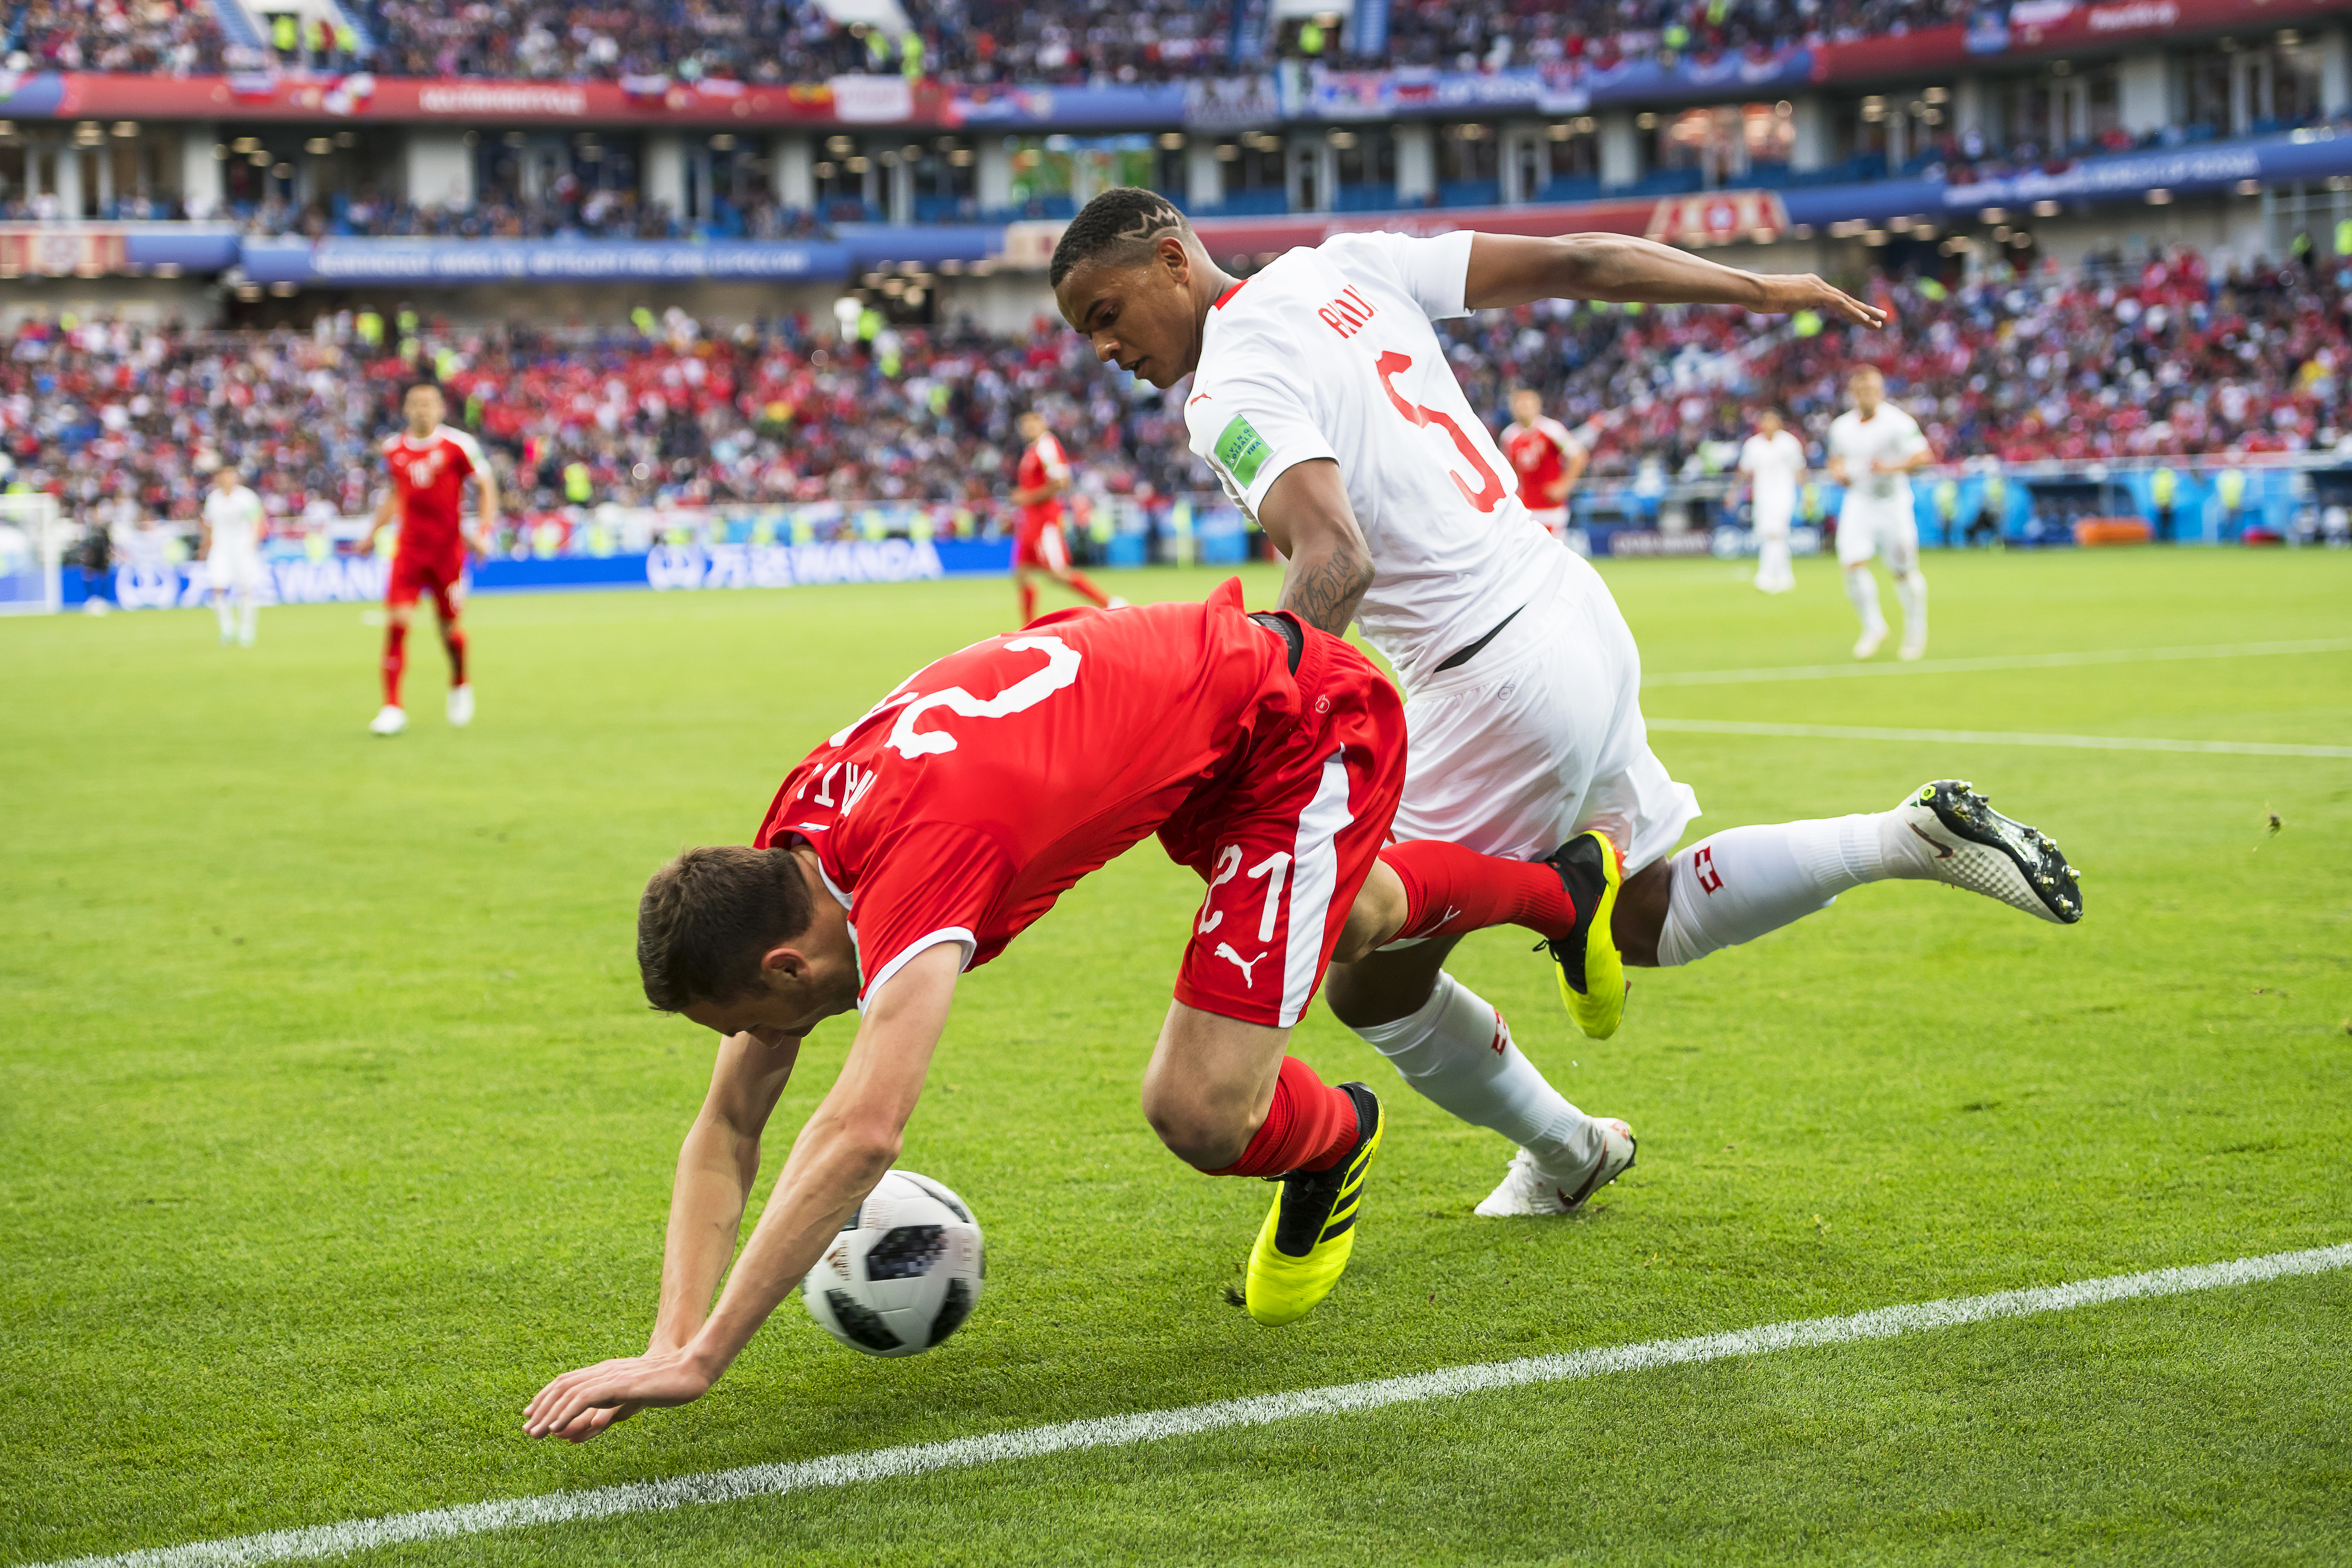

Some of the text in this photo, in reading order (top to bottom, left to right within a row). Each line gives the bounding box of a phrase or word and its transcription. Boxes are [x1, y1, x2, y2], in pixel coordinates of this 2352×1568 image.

[1247, 441, 1261, 455] FIFA
[1375, 350, 1506, 512] 5
[273, 560, 388, 603] WAN
[792, 539, 943, 585] WANDA
[1198, 844, 1294, 942] 21
